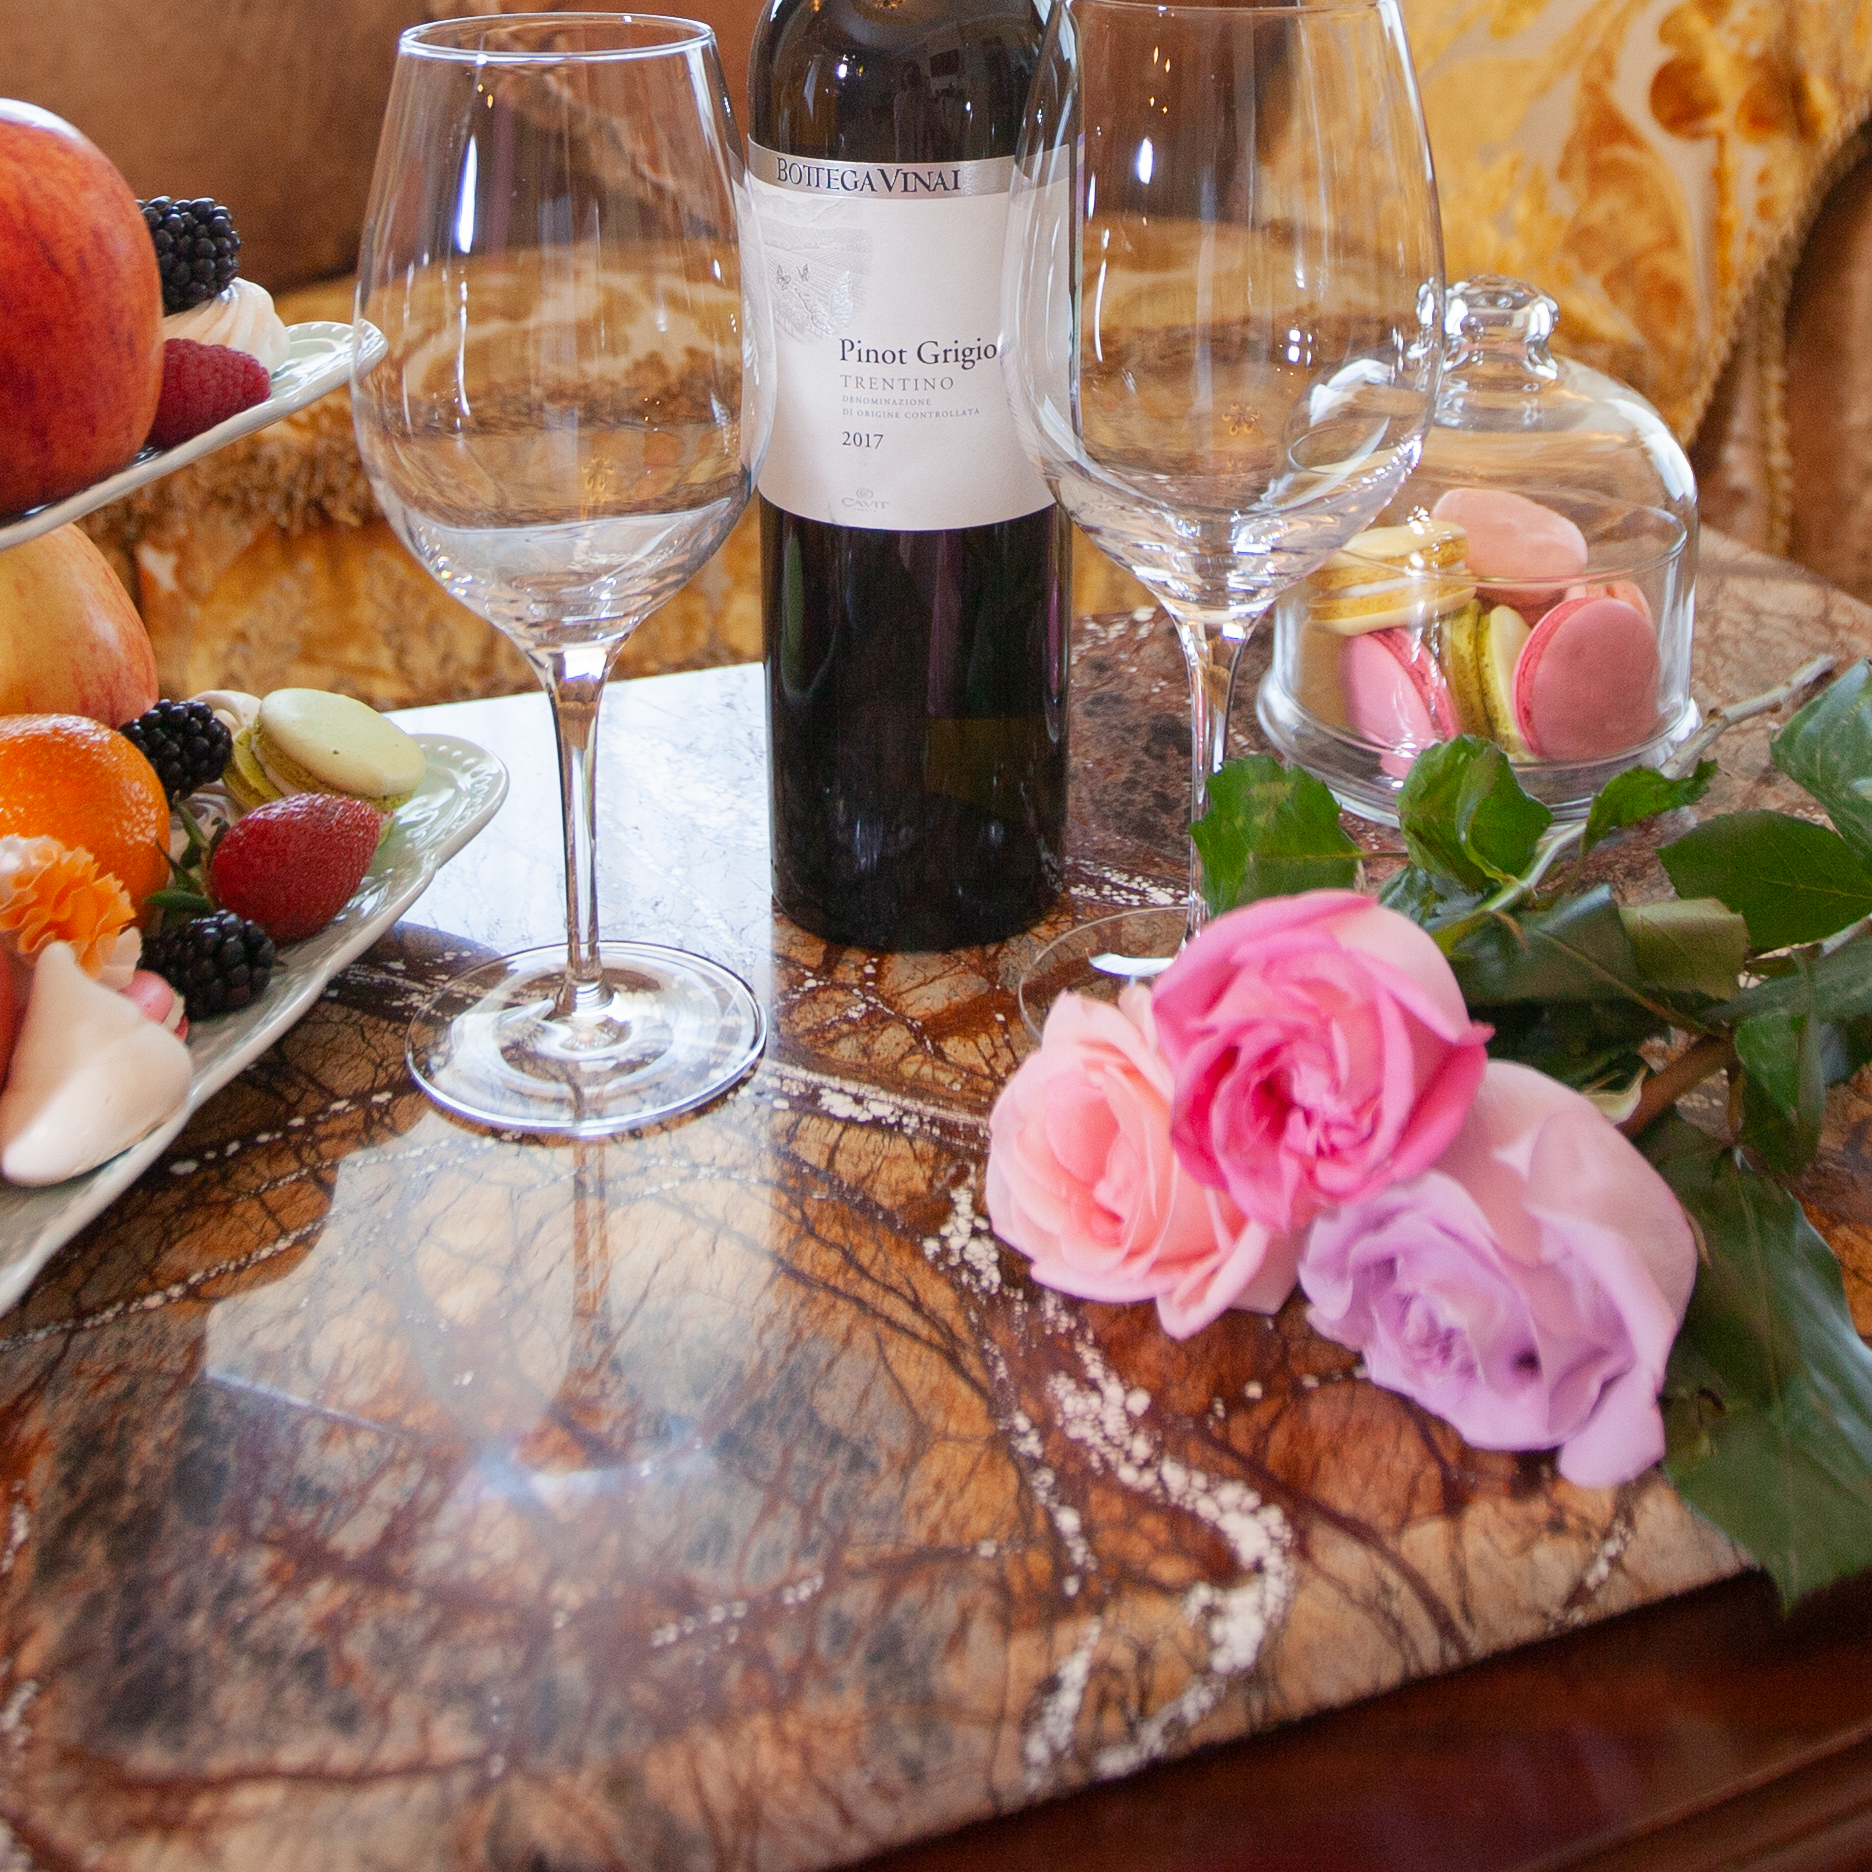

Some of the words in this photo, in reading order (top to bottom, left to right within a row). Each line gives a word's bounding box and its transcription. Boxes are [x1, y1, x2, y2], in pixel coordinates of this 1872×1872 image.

[839, 338, 908, 364] Pinot
[916, 337, 997, 370] Grigio
[840, 374, 954, 391] TRENTINO
[842, 395, 932, 406] DENOMINAZIONE
[842, 408, 853, 416] DI
[857, 409, 901, 419] ORIGINE
[904, 408, 980, 419] CONTROLLATA
[841, 431, 884, 449] 2017
